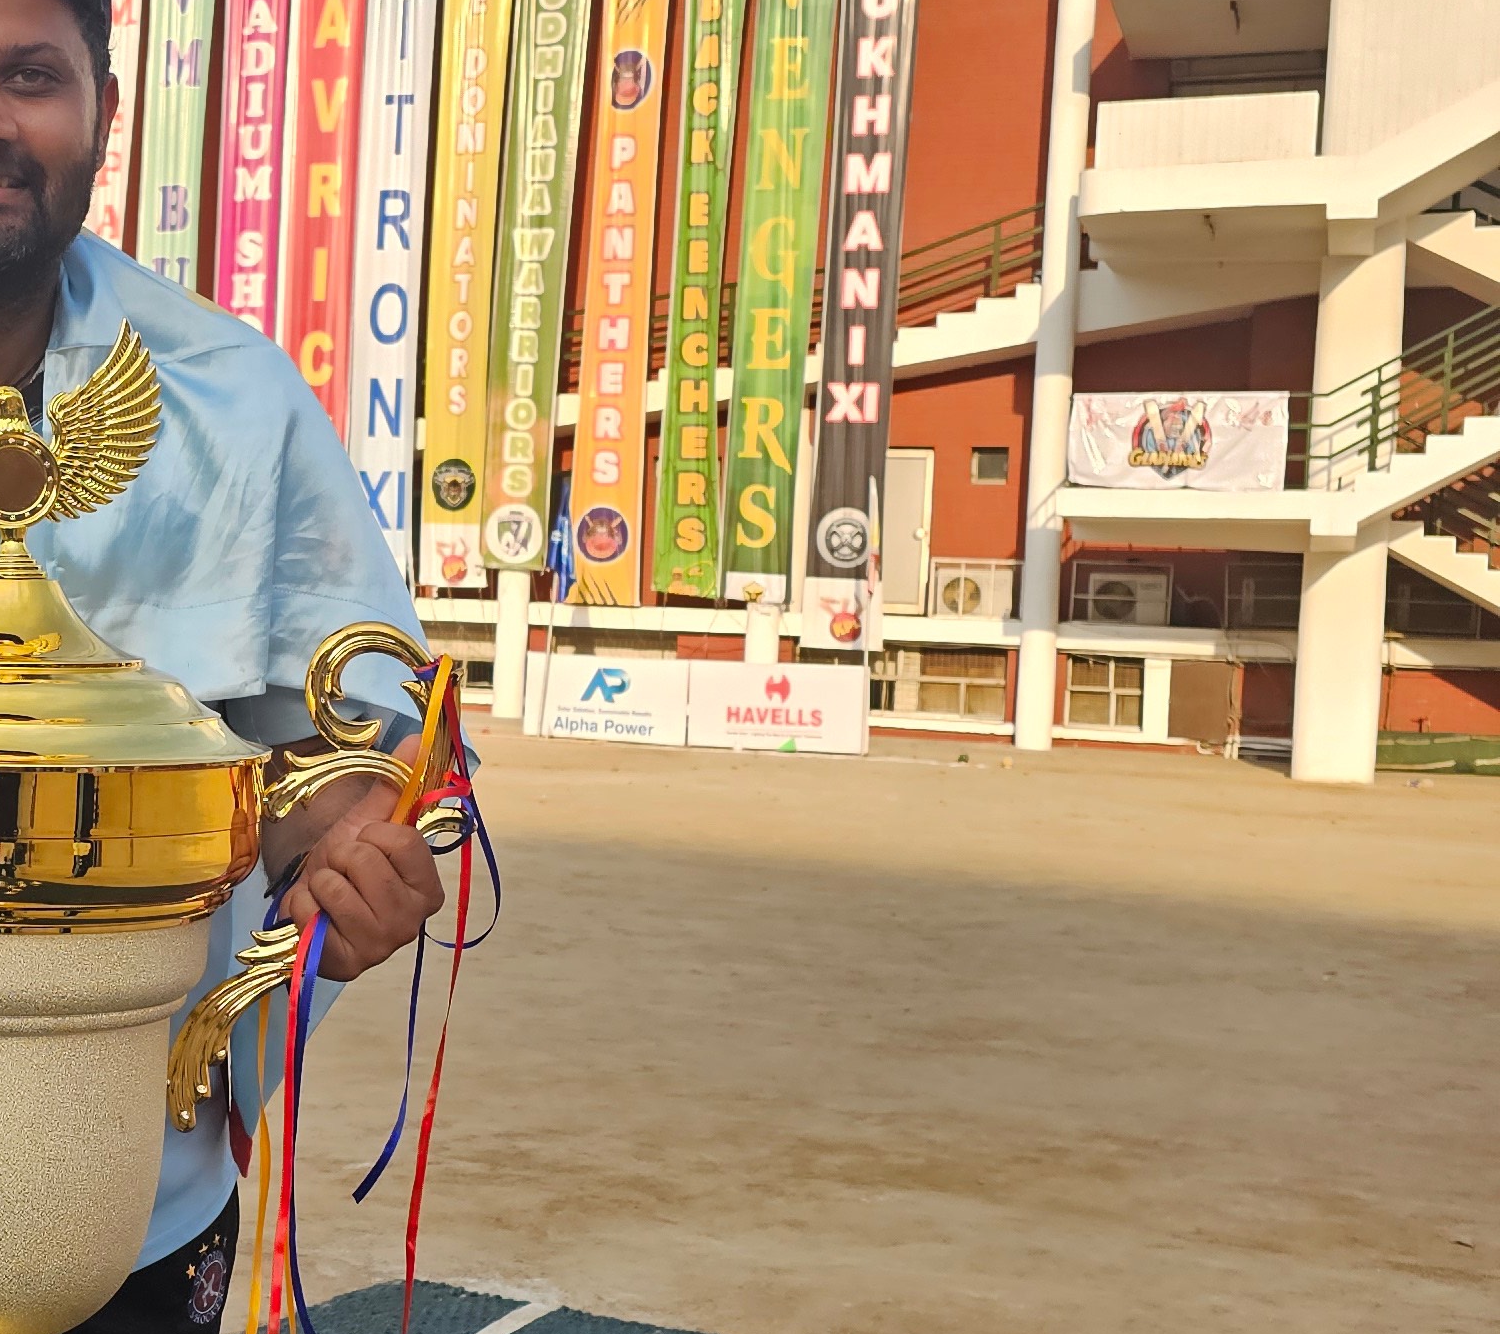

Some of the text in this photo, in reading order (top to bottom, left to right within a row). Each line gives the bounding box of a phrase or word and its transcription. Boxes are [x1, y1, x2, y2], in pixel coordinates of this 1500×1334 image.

[593, 136, 637, 485] PANTHERS
[501, 227, 555, 498] WARRIORS
[825, 382, 880, 424] XI
[554, 717, 654, 736] Alpha Power
[727, 707, 822, 727] HAVELLS
